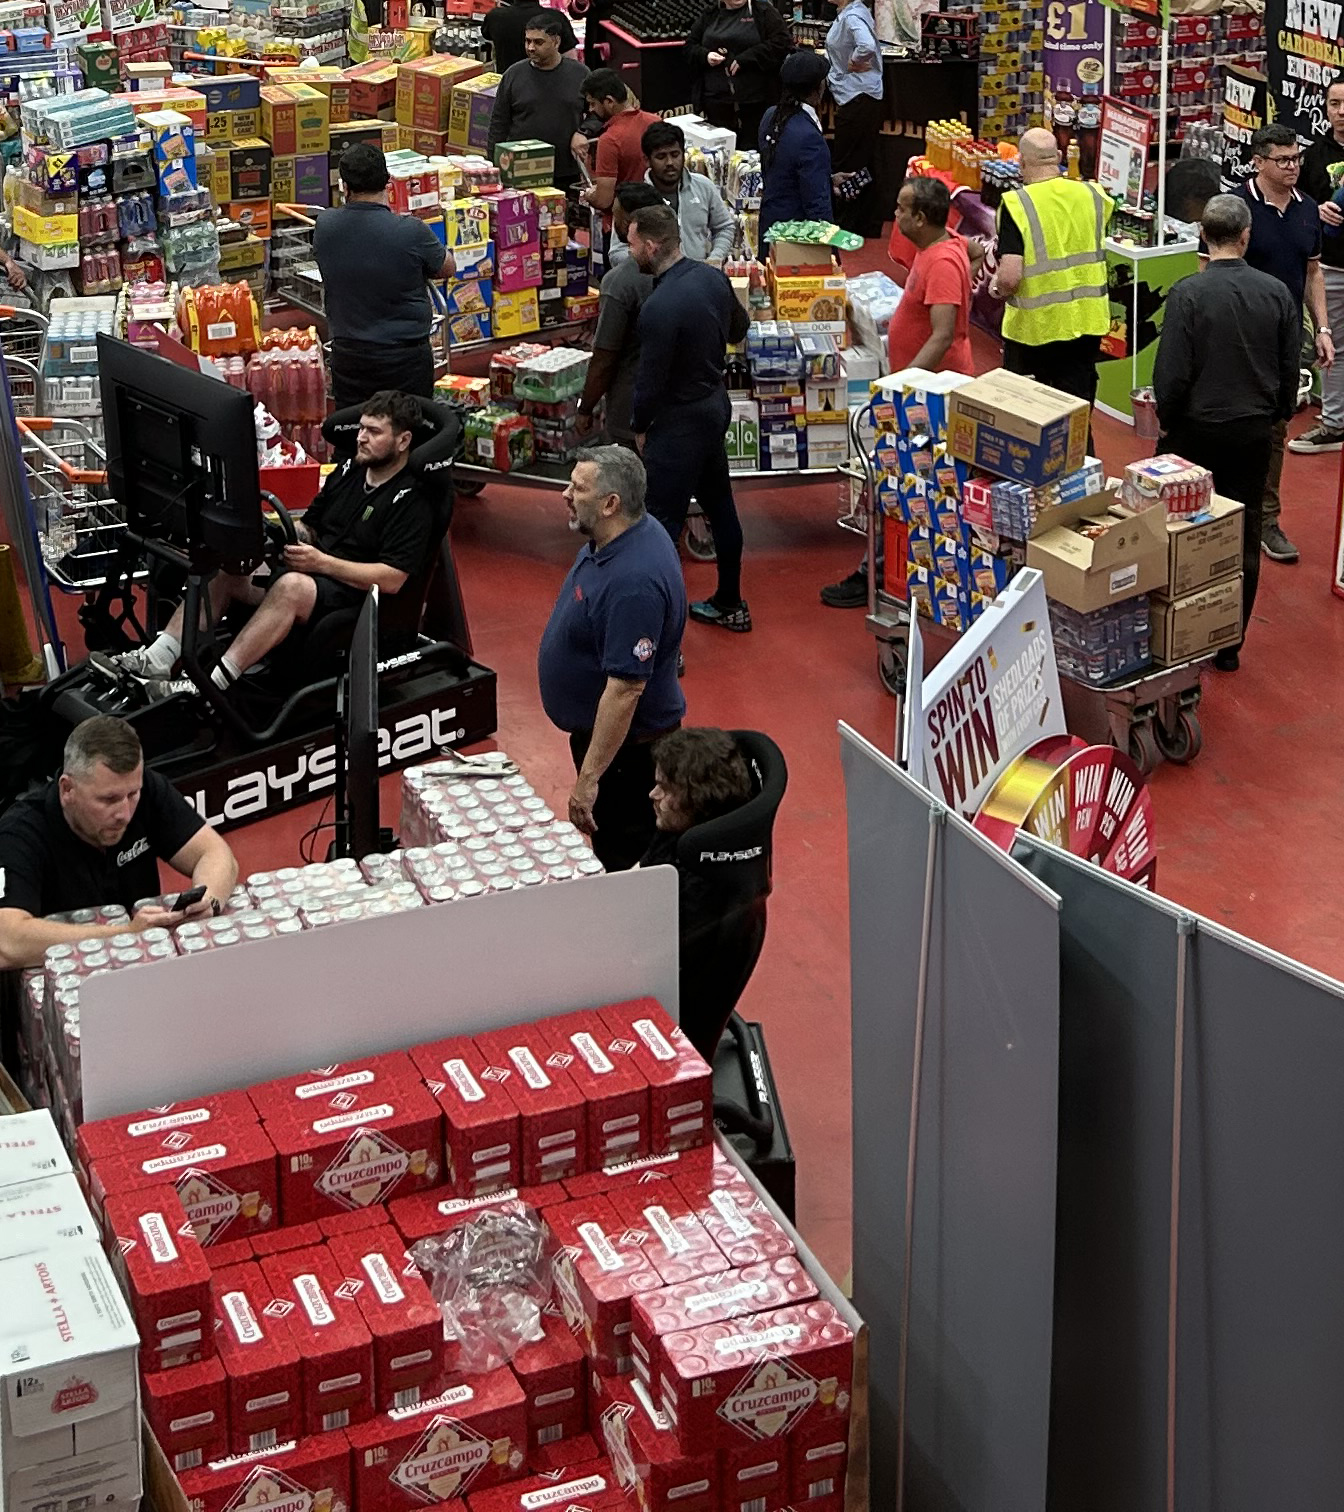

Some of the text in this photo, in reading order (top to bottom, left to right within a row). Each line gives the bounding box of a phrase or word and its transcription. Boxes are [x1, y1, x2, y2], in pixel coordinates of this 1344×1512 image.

[1046, 2, 1088, 40] £1
[1294, 88, 1325, 117] Levi
[993, 630, 1047, 709] SHEDLOADS
[927, 656, 987, 749] SPIN TO
[1011, 669, 1043, 716] PRIZES
[1075, 764, 1105, 808] WIN
[328, 1157, 403, 1187] Cruzcampo
[730, 1385, 811, 1414] Cruzcampo
[405, 1445, 484, 1479] Cruzcampo
